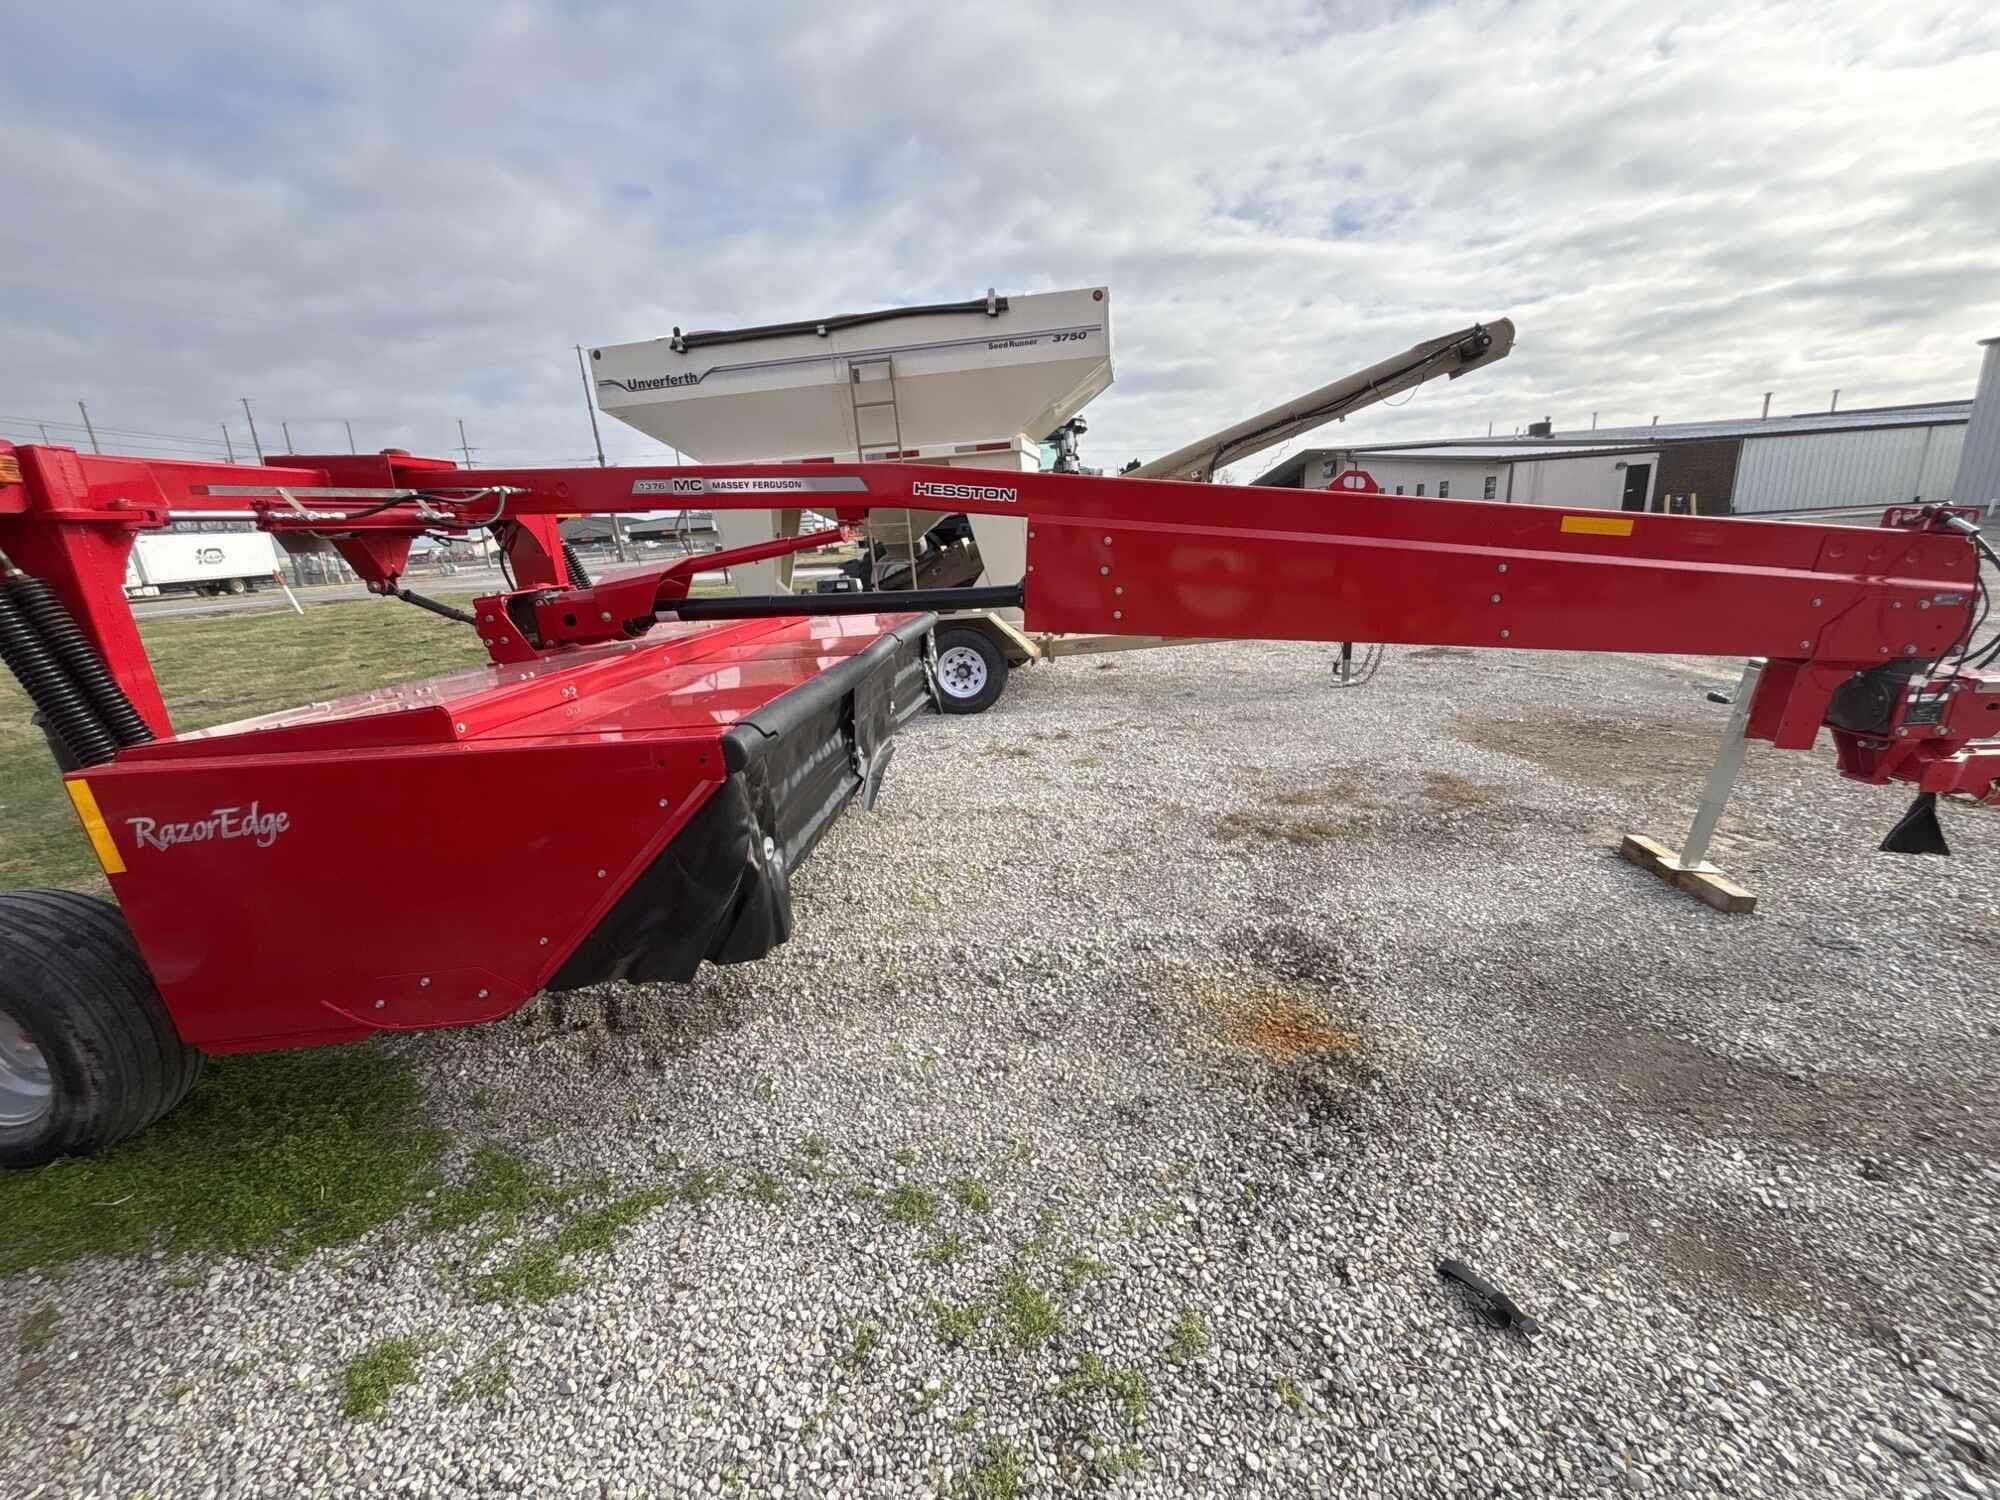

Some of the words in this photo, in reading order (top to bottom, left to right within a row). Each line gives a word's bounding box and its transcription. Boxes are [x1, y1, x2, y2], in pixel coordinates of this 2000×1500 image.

[1052, 332, 1087, 343] 3750
[627, 372, 698, 390] Unverferth
[673, 479, 702, 491] MC
[712, 481, 749, 489] MASSEY
[752, 480, 802, 489] FERGUSON
[913, 482, 1017, 502] HESSTON
[125, 800, 290, 852] RazorEdge
